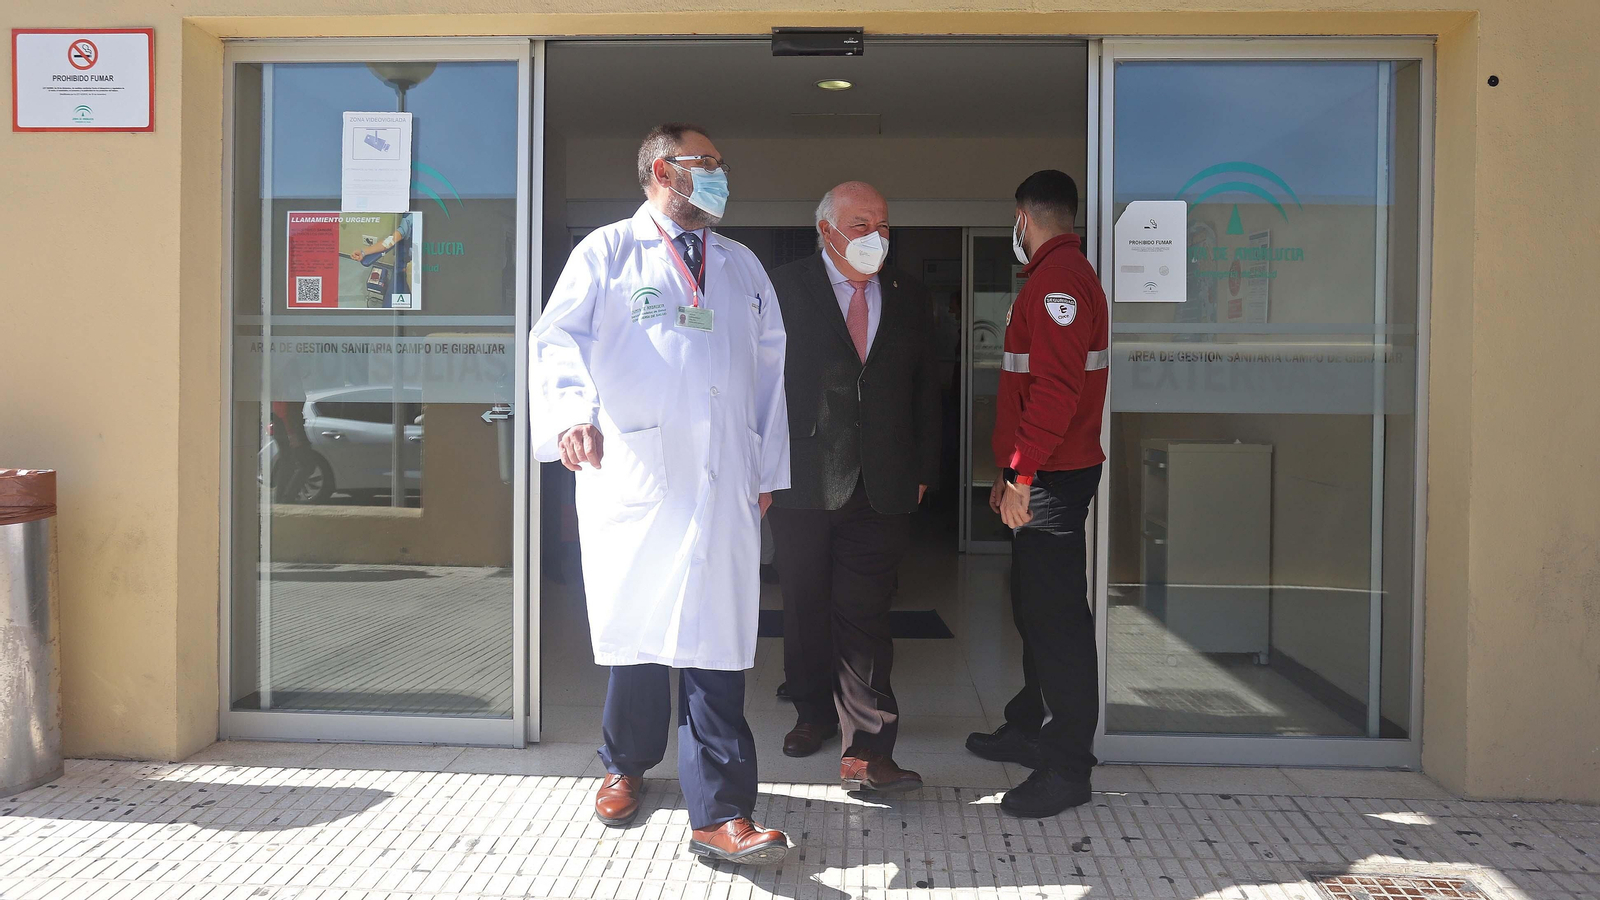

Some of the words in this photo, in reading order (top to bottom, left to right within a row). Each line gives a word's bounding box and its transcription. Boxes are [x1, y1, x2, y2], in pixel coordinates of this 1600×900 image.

[422, 242, 464, 256] ALUCIA
[250, 342, 276, 353] ARA
[279, 342, 293, 353] DE
[296, 342, 338, 354] GESTION
[341, 343, 392, 354] SANITARIA
[396, 343, 432, 354] CAMPO
[434, 343, 449, 354] DE
[451, 343, 505, 354] GIBRALTAR
[1128, 350, 1156, 362] AREA
[1159, 350, 1175, 362] DE
[1177, 350, 1222, 363] GESTION
[1227, 351, 1282, 364] SANITARIA
[1284, 352, 1324, 364] CAMPO
